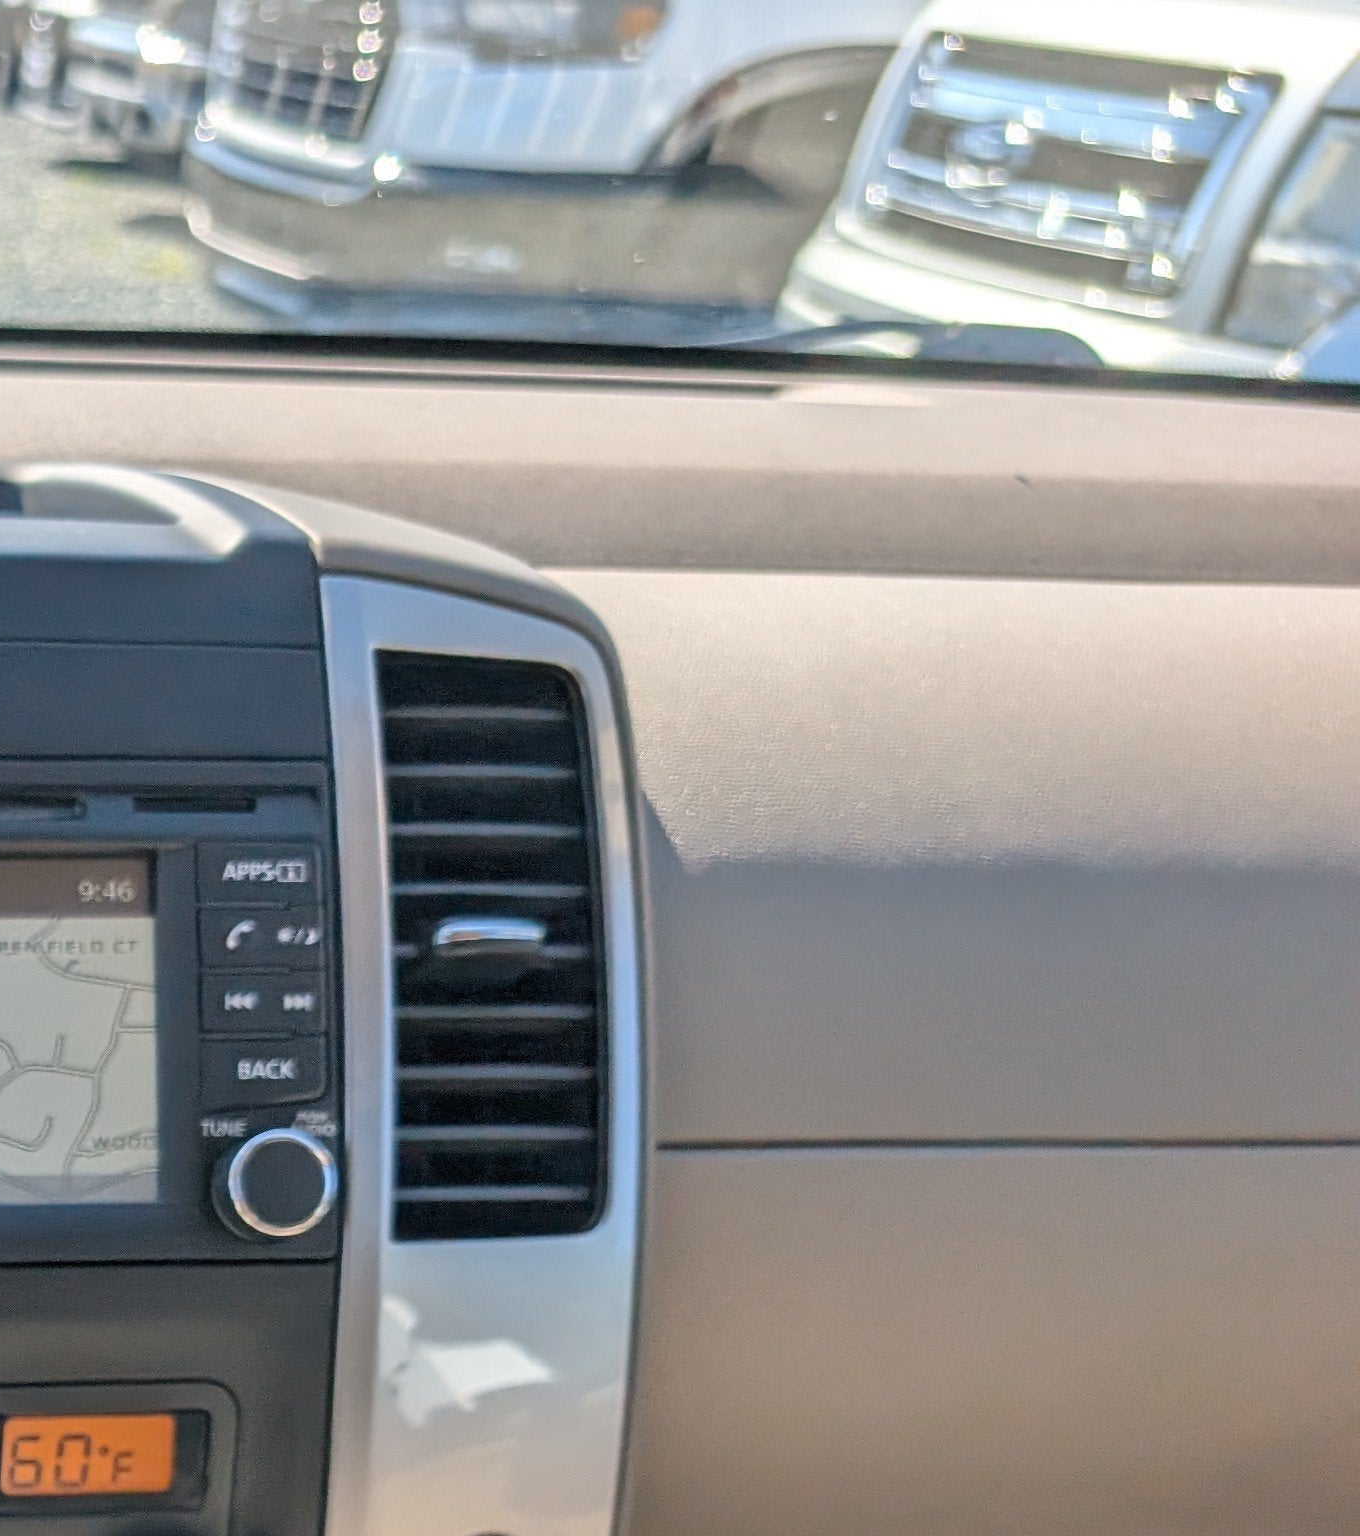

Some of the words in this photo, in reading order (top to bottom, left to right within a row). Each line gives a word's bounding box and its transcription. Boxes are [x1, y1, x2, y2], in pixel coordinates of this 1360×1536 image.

[78, 880, 135, 902] 9:46
[237, 1058, 296, 1080] BACK
[200, 1118, 247, 1137] TUNE
